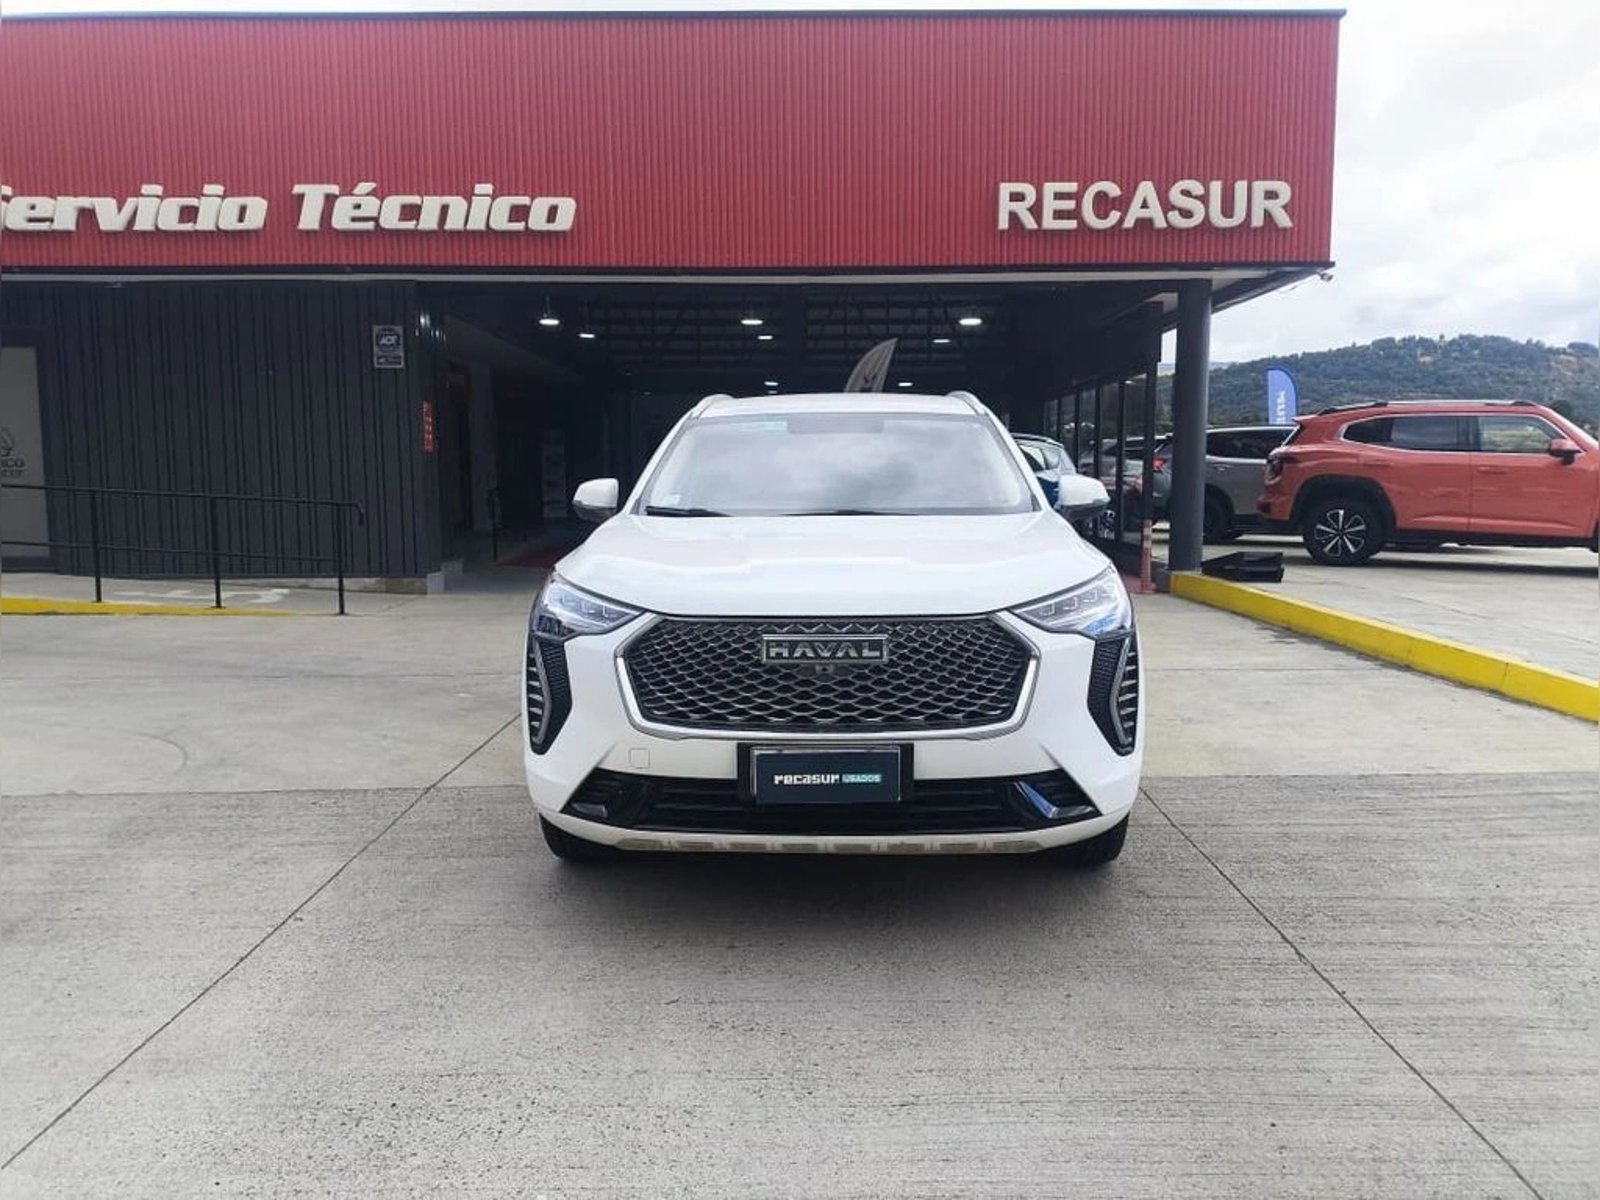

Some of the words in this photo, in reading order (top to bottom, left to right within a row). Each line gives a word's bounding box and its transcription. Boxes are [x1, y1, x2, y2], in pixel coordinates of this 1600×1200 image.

[0, 184, 268, 232] ervicio
[291, 182, 577, 232] Técnico
[997, 179, 1293, 230] RECASUR
[768, 641, 881, 658] HAVAL
[773, 773, 840, 785] recasur
[841, 773, 882, 784] USADOS
